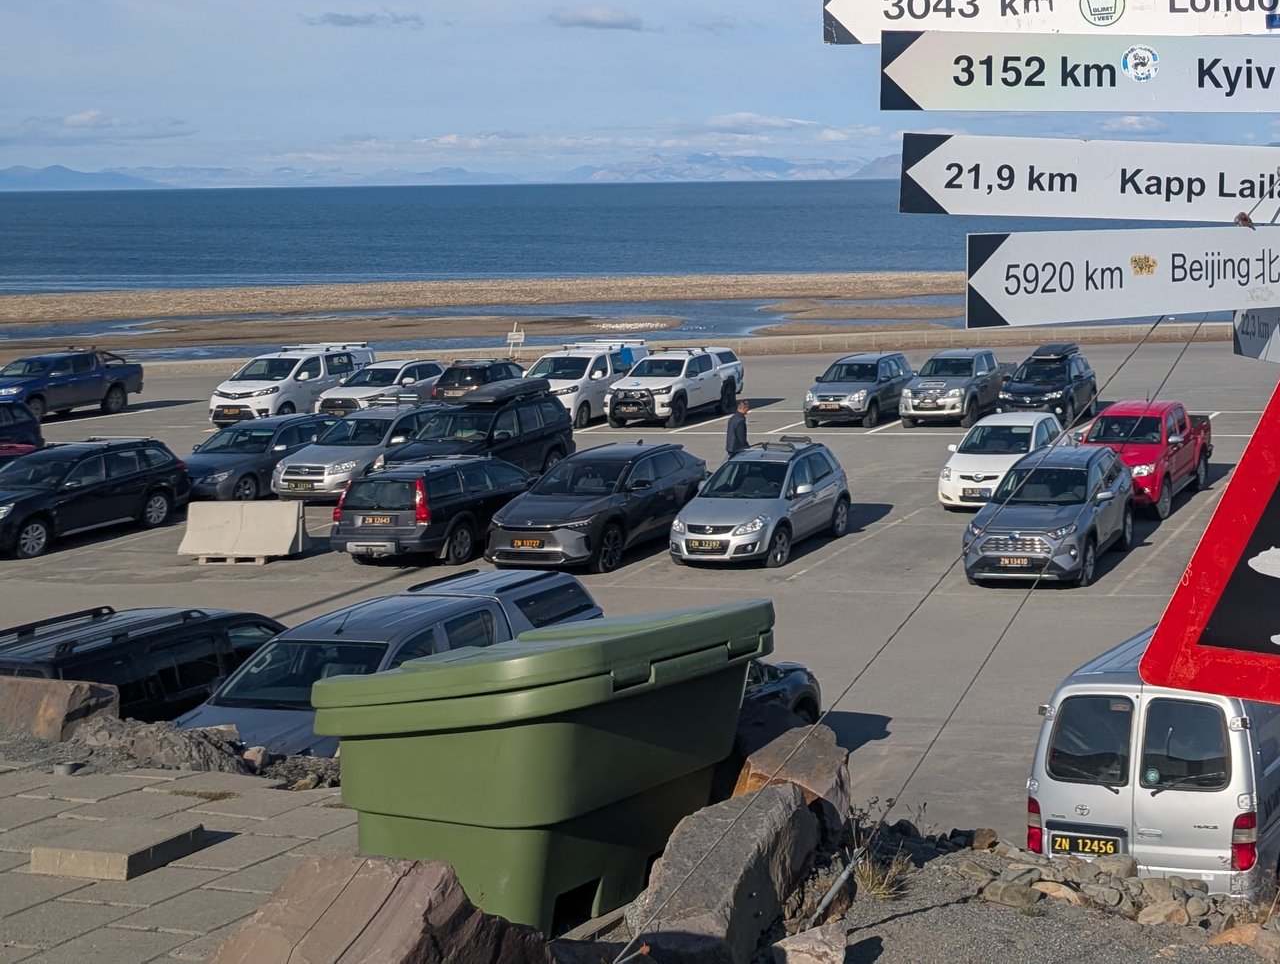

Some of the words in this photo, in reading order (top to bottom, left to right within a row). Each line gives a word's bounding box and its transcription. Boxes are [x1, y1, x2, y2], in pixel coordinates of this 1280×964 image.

[952, 55, 1046, 87] 3152
[1060, 55, 1117, 87] km
[1197, 56, 1276, 97] Kyiv
[944, 162, 1016, 196] 21,9
[1027, 164, 1078, 193] km
[1120, 168, 1206, 203] Kapp
[1004, 260, 1075, 296] 5920
[1085, 259, 1124, 291] km
[364, 516, 374, 524] ZN
[513, 539, 522, 547] ZN
[1000, 557, 1009, 565] ZN
[1054, 837, 1070, 851] ZN
[1077, 839, 1115, 854] 12456
